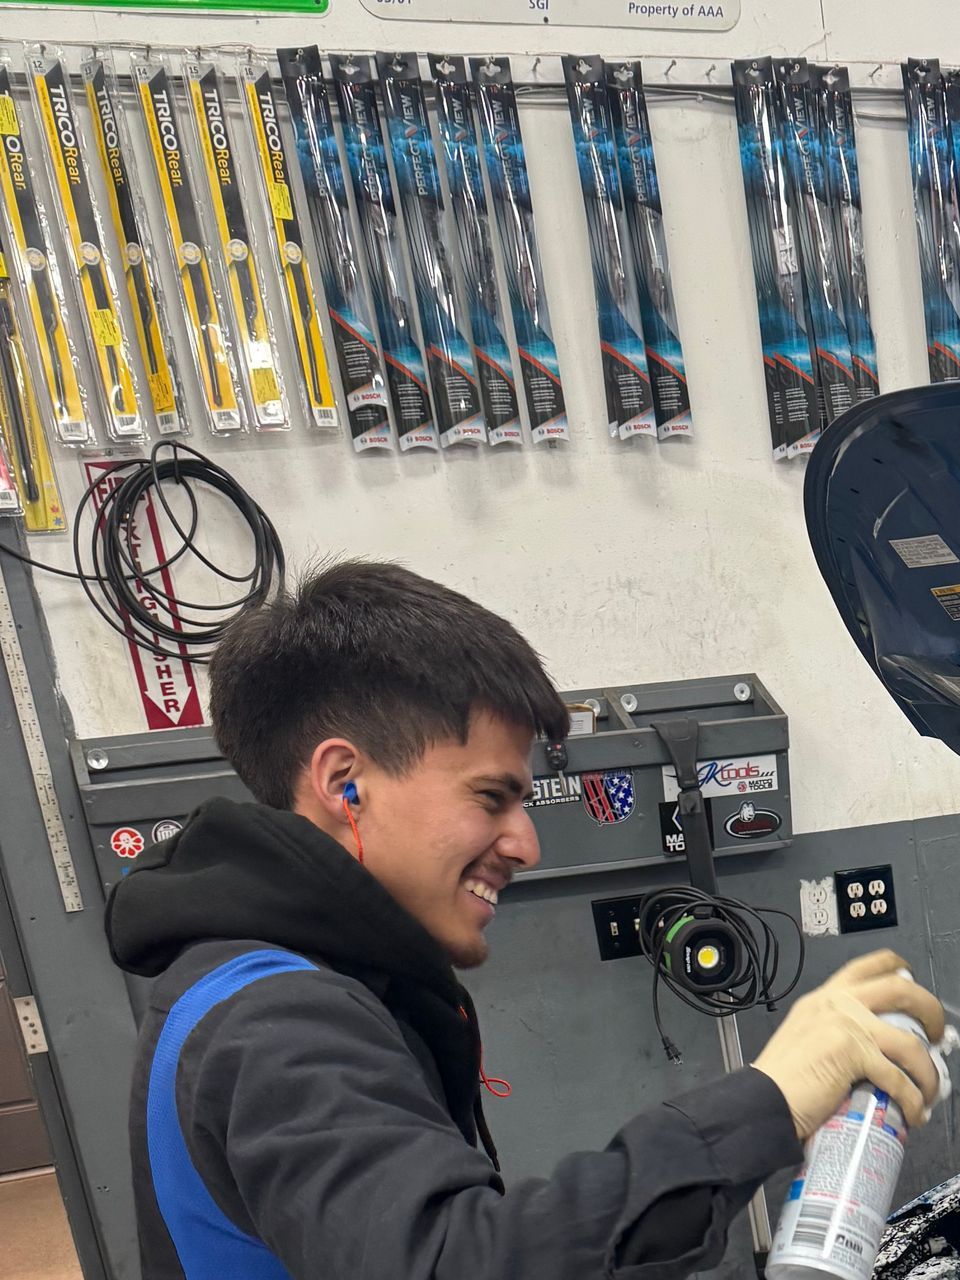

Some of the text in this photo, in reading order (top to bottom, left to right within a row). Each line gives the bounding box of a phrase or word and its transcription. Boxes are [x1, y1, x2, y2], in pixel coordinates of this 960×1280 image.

[628, 2, 723, 18] Property of AAA
[531, 775, 582, 800] STEIN
[535, 796, 580, 806] ABSORBERS
